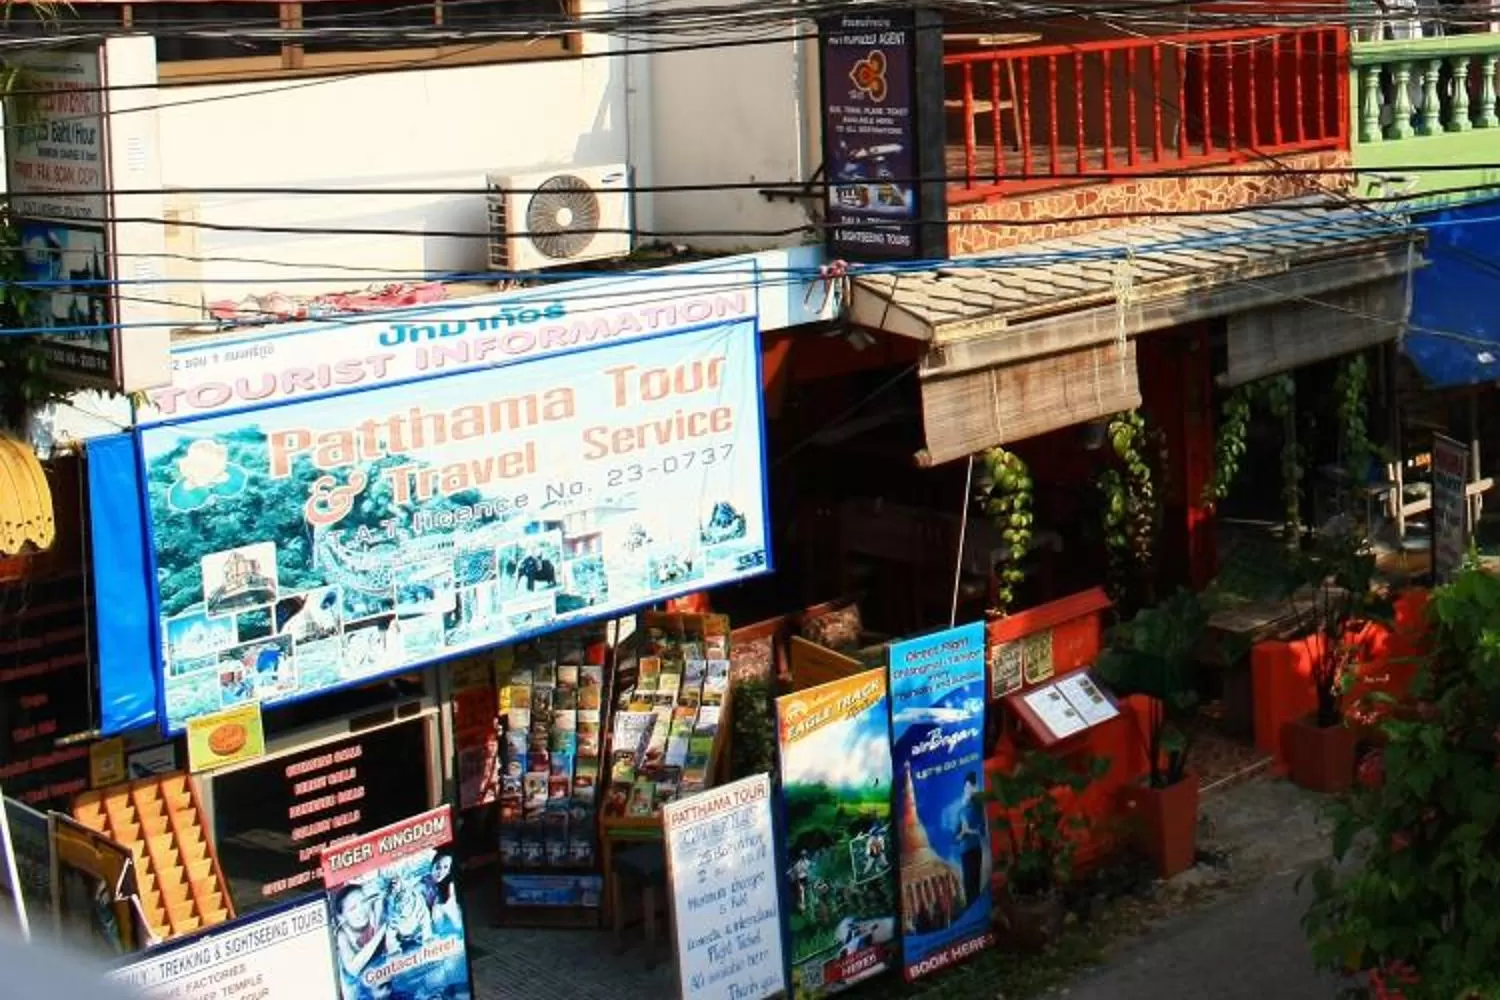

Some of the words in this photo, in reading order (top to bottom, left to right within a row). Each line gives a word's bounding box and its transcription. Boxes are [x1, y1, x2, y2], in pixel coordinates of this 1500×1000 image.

[152, 352, 396, 415] TOURIST
[415, 293, 748, 371] INFORMATION
[268, 386, 576, 479] Patthama
[604, 352, 727, 408] Tour
[306, 472, 367, 525] &
[384, 441, 537, 505] Travel
[582, 404, 733, 461] Service
[546, 477, 593, 502] No.
[607, 442, 735, 488] 23-0737
[671, 795, 732, 824] PATTHAMA
[733, 783, 766, 805] TOUR
[329, 844, 373, 870] TIGER
[379, 814, 446, 854] KINGDOM
[160, 947, 211, 979] TREKKING
[224, 921, 289, 951] SIGHTSEEING
[292, 907, 324, 933] TOURS
[365, 954, 420, 984] Contact
[909, 954, 949, 978] BOOK
[185, 963, 246, 993] FACTORIES
[221, 973, 263, 997] TEMPLE
